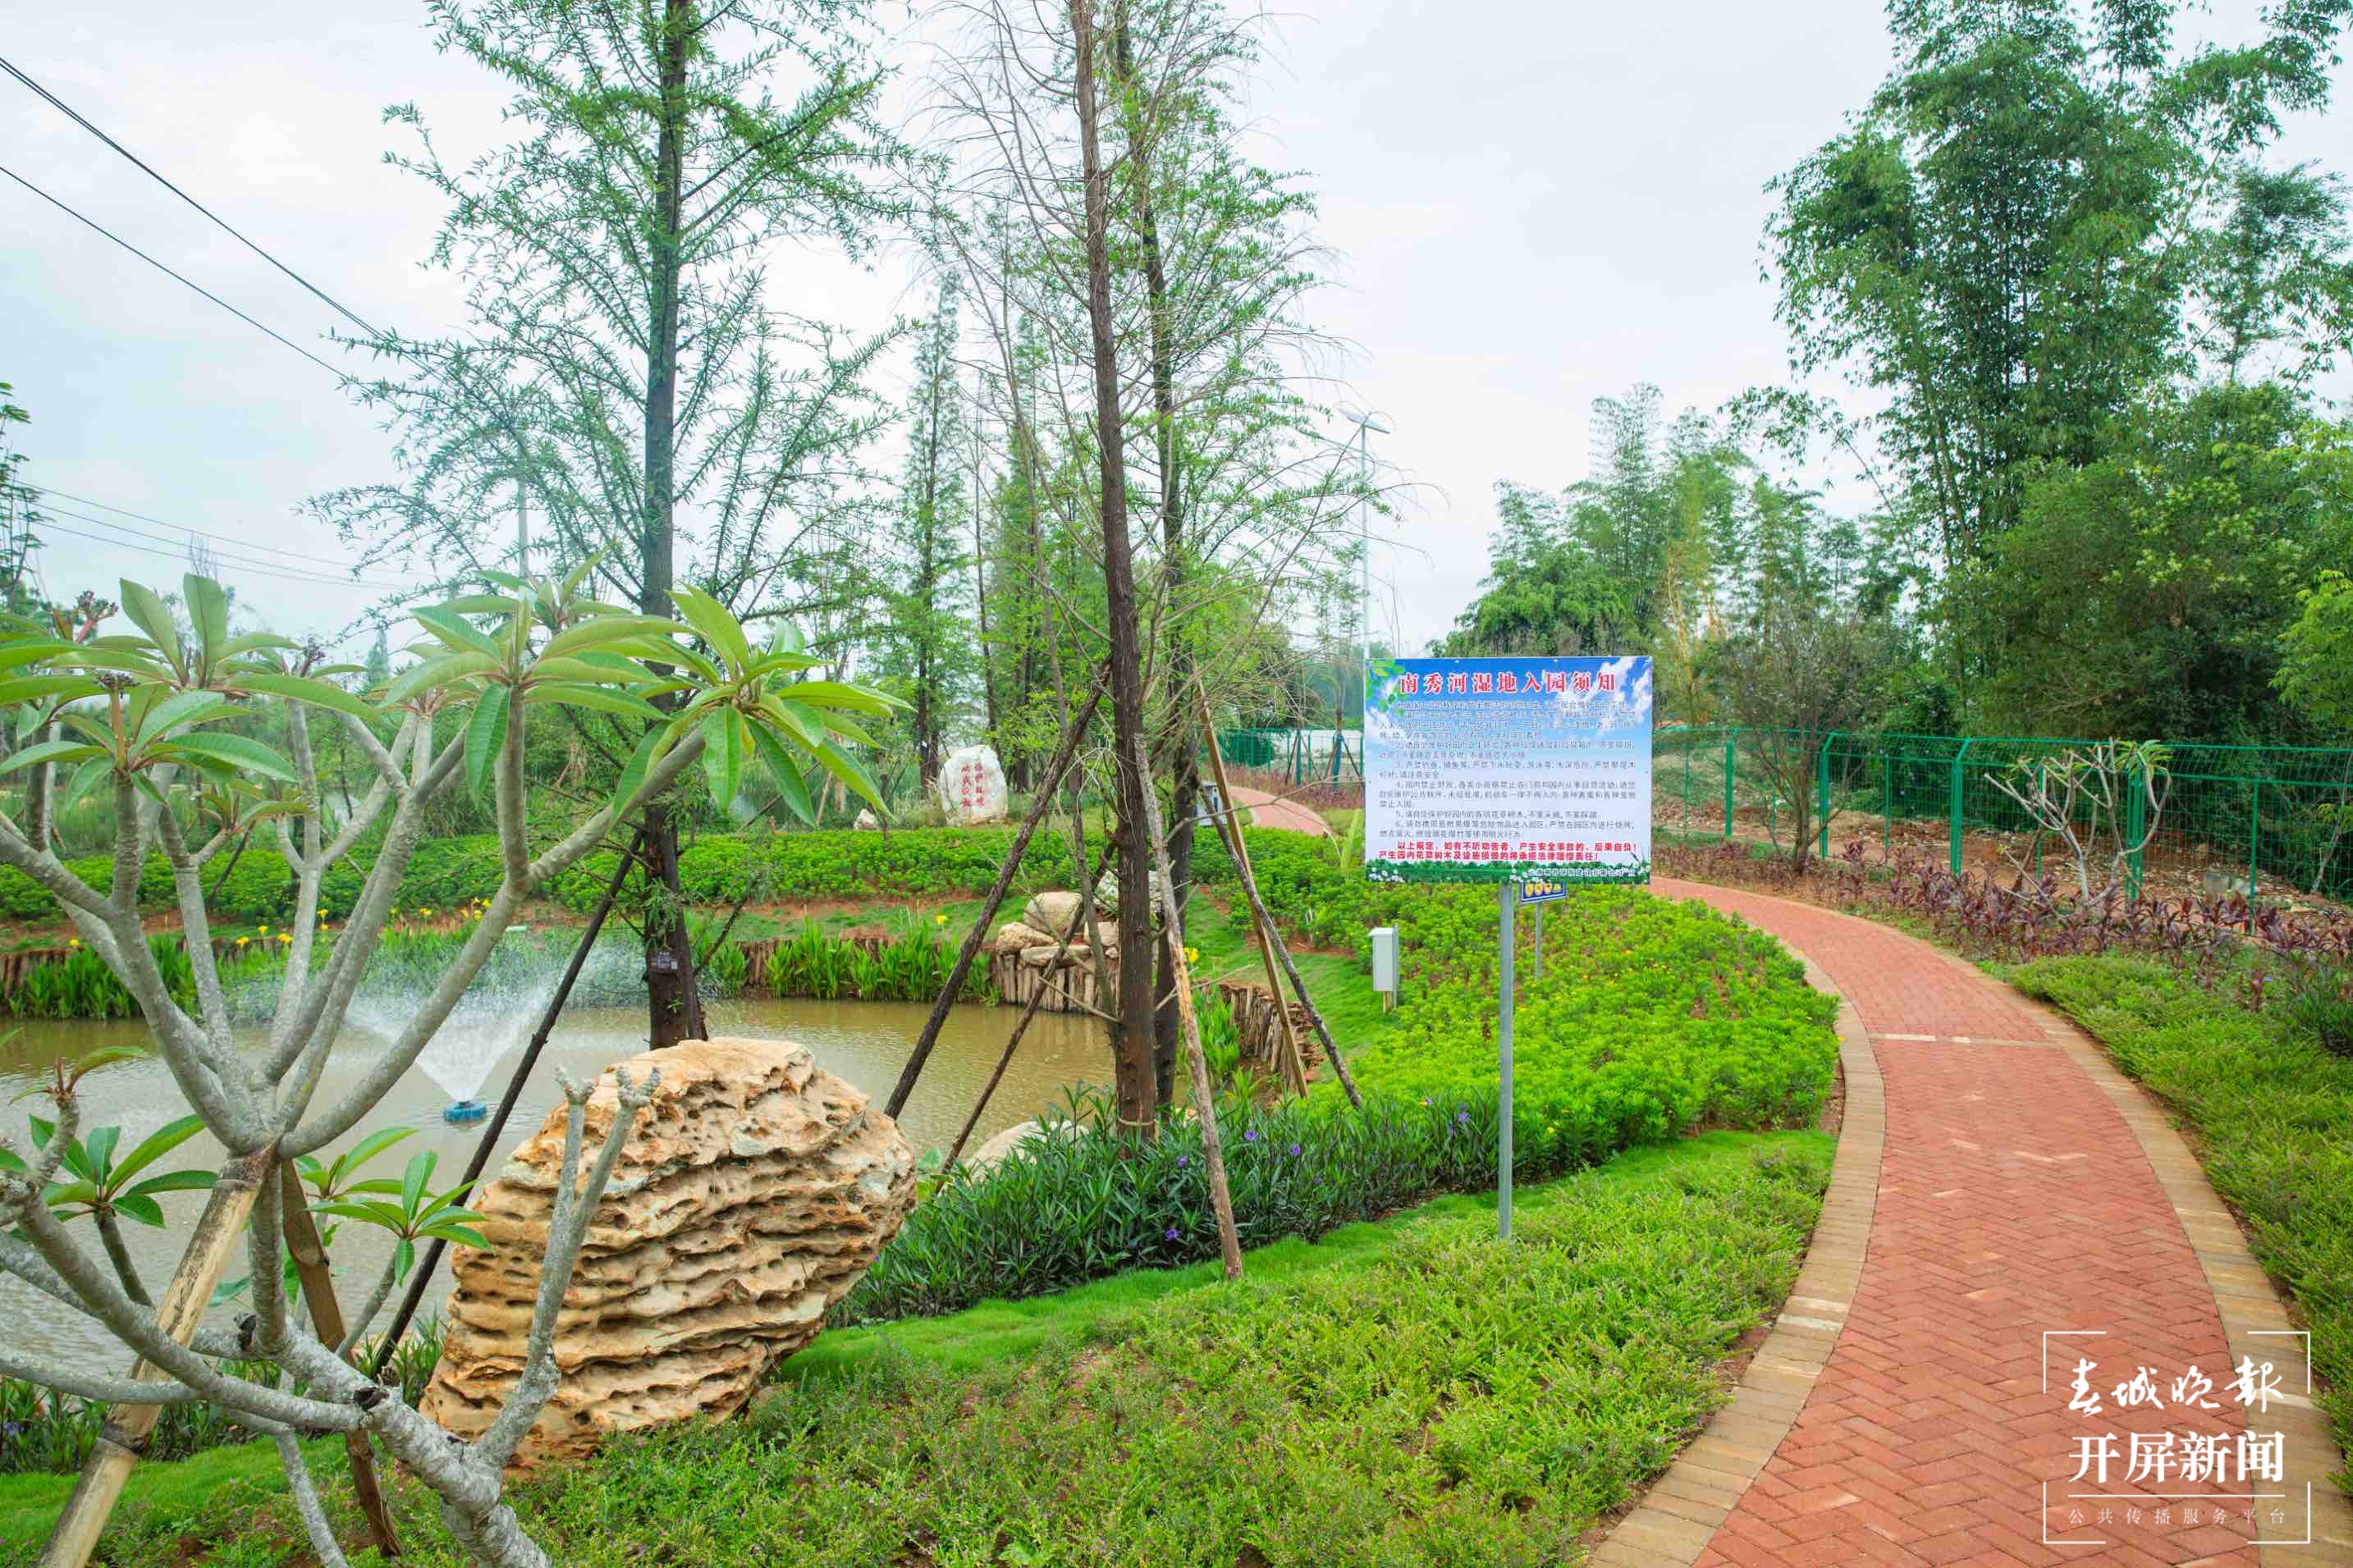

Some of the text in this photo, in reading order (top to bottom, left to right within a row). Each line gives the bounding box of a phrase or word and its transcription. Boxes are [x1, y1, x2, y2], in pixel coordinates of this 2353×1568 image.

[1399, 671, 1616, 693] 南秀河湿地入园须知
